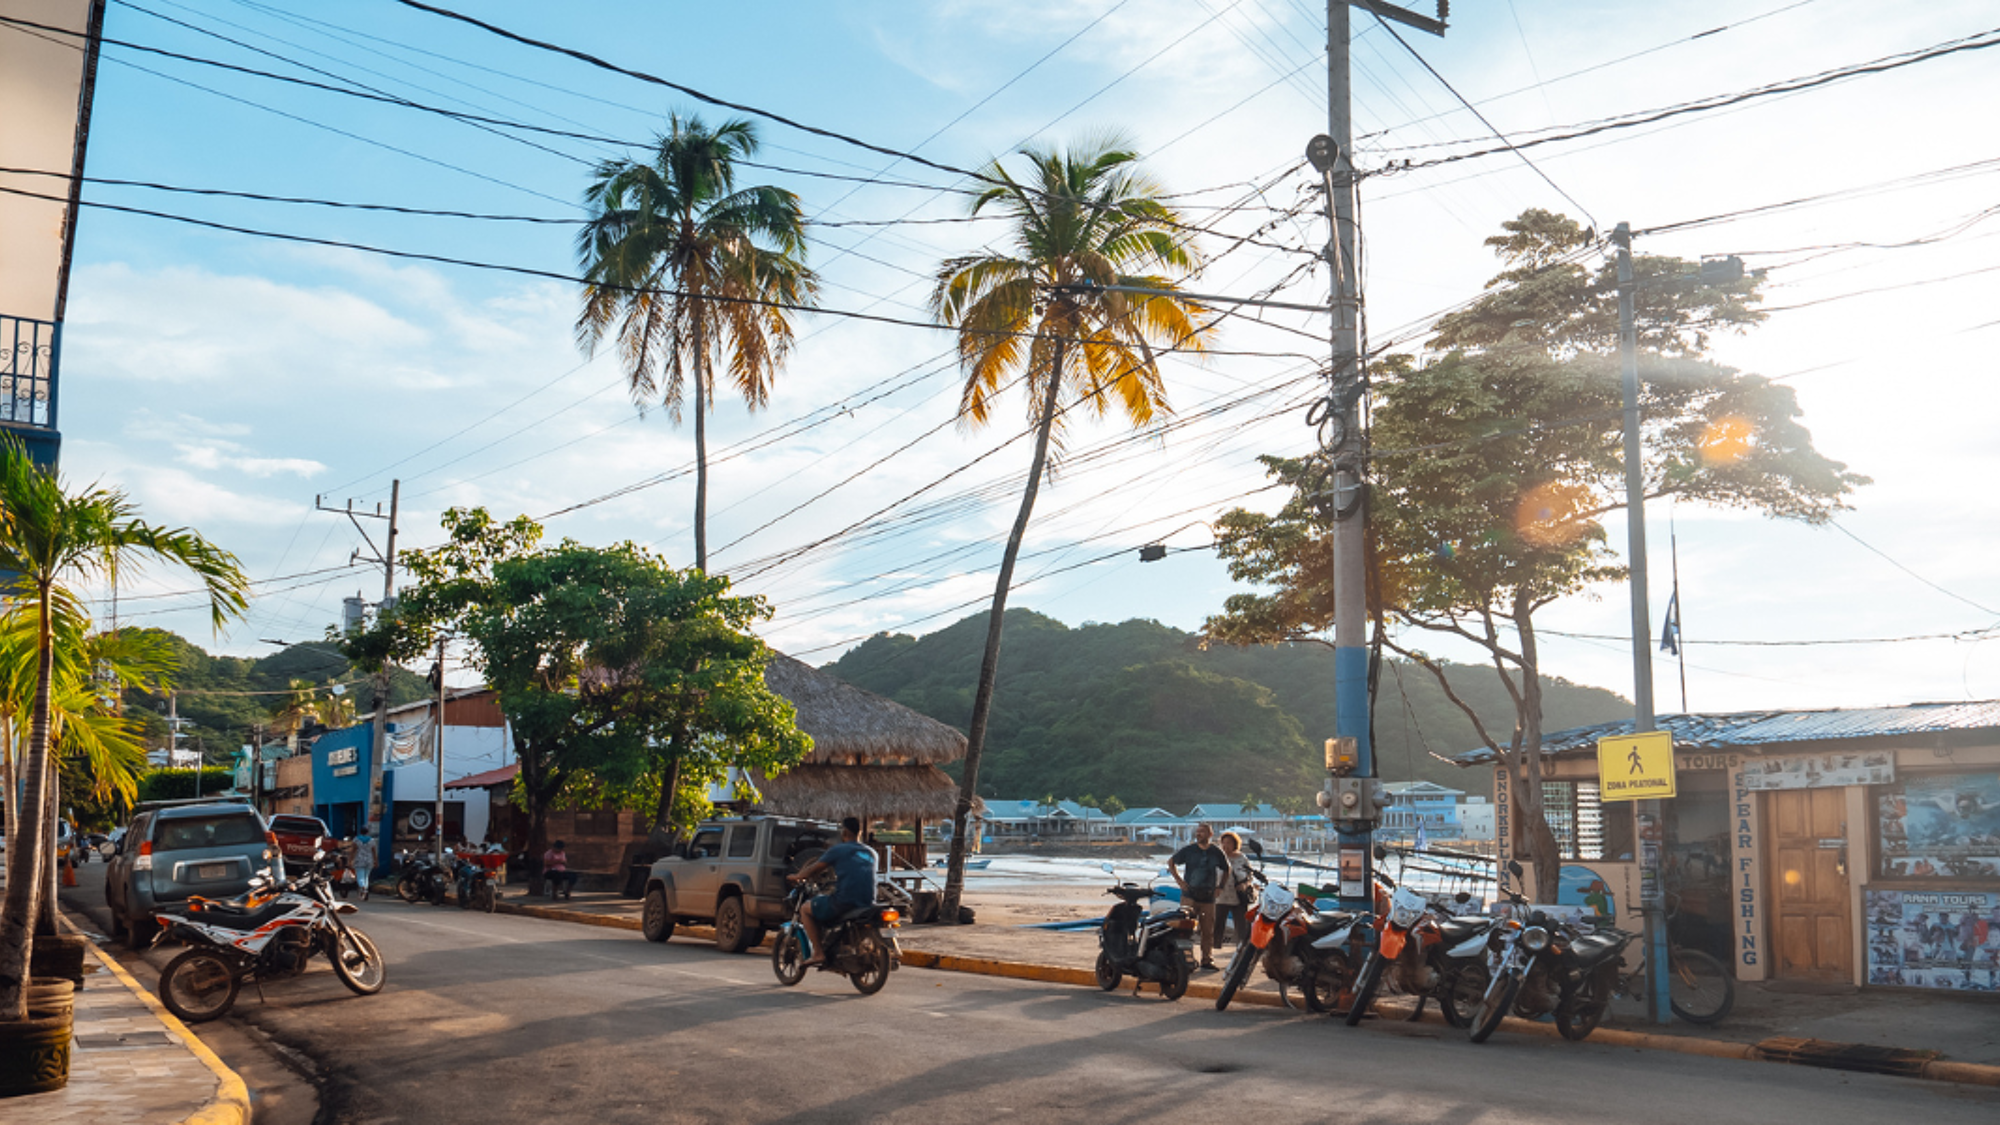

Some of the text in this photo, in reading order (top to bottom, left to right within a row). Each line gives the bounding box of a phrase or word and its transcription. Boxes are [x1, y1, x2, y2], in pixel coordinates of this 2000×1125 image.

[1682, 754, 1738, 769] TOURS
[1607, 781, 1627, 790] ZONA
[1735, 772, 1757, 966] SPEAR FISHING
[1902, 893, 1986, 905] RANA TOURS
